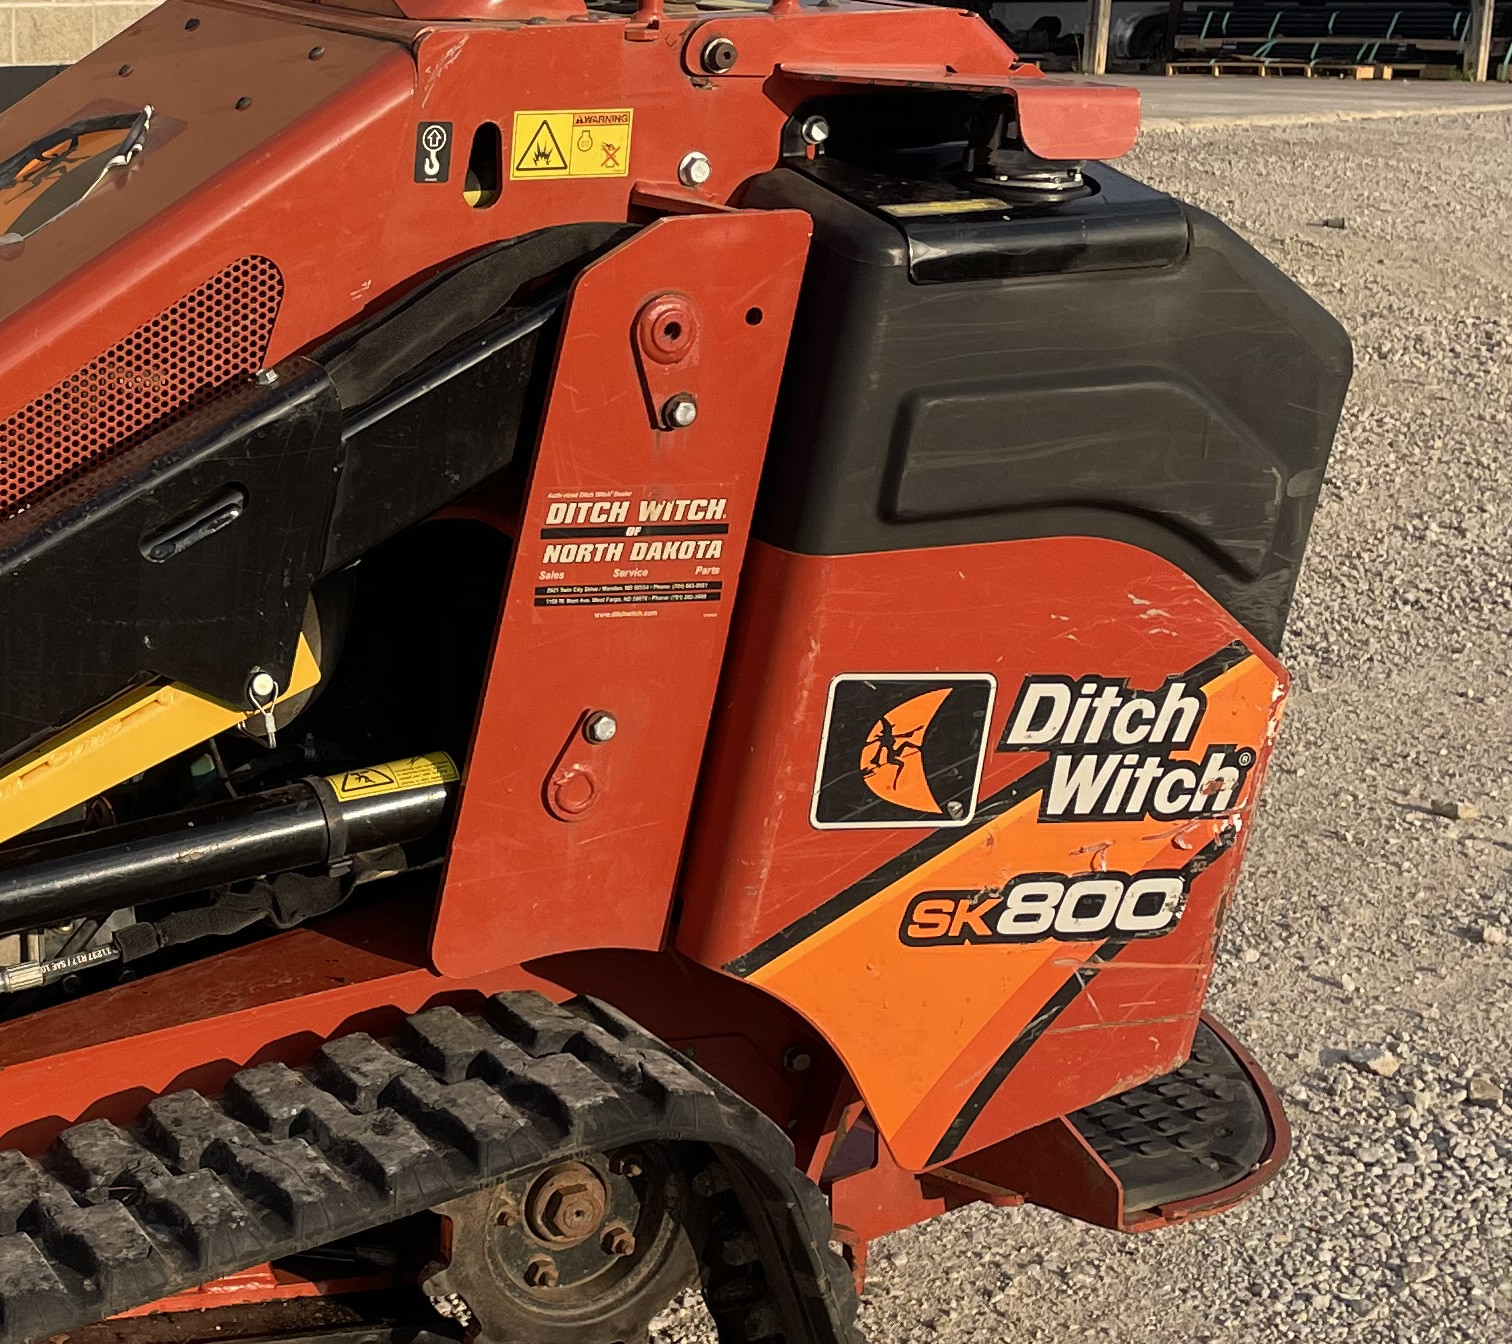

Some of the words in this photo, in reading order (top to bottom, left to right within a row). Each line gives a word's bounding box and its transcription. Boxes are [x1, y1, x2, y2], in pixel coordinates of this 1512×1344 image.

[584, 114, 629, 124] WARNING
[545, 501, 631, 525] DITCH
[626, 526, 642, 536] OF
[542, 542, 625, 564] NORTH
[629, 540, 723, 562] DAKOTA
[539, 570, 565, 581] Sales
[612, 568, 648, 578] Service
[695, 566, 720, 576] Parts
[1006, 682, 1200, 745] Ditch
[905, 877, 1187, 939] SK800
